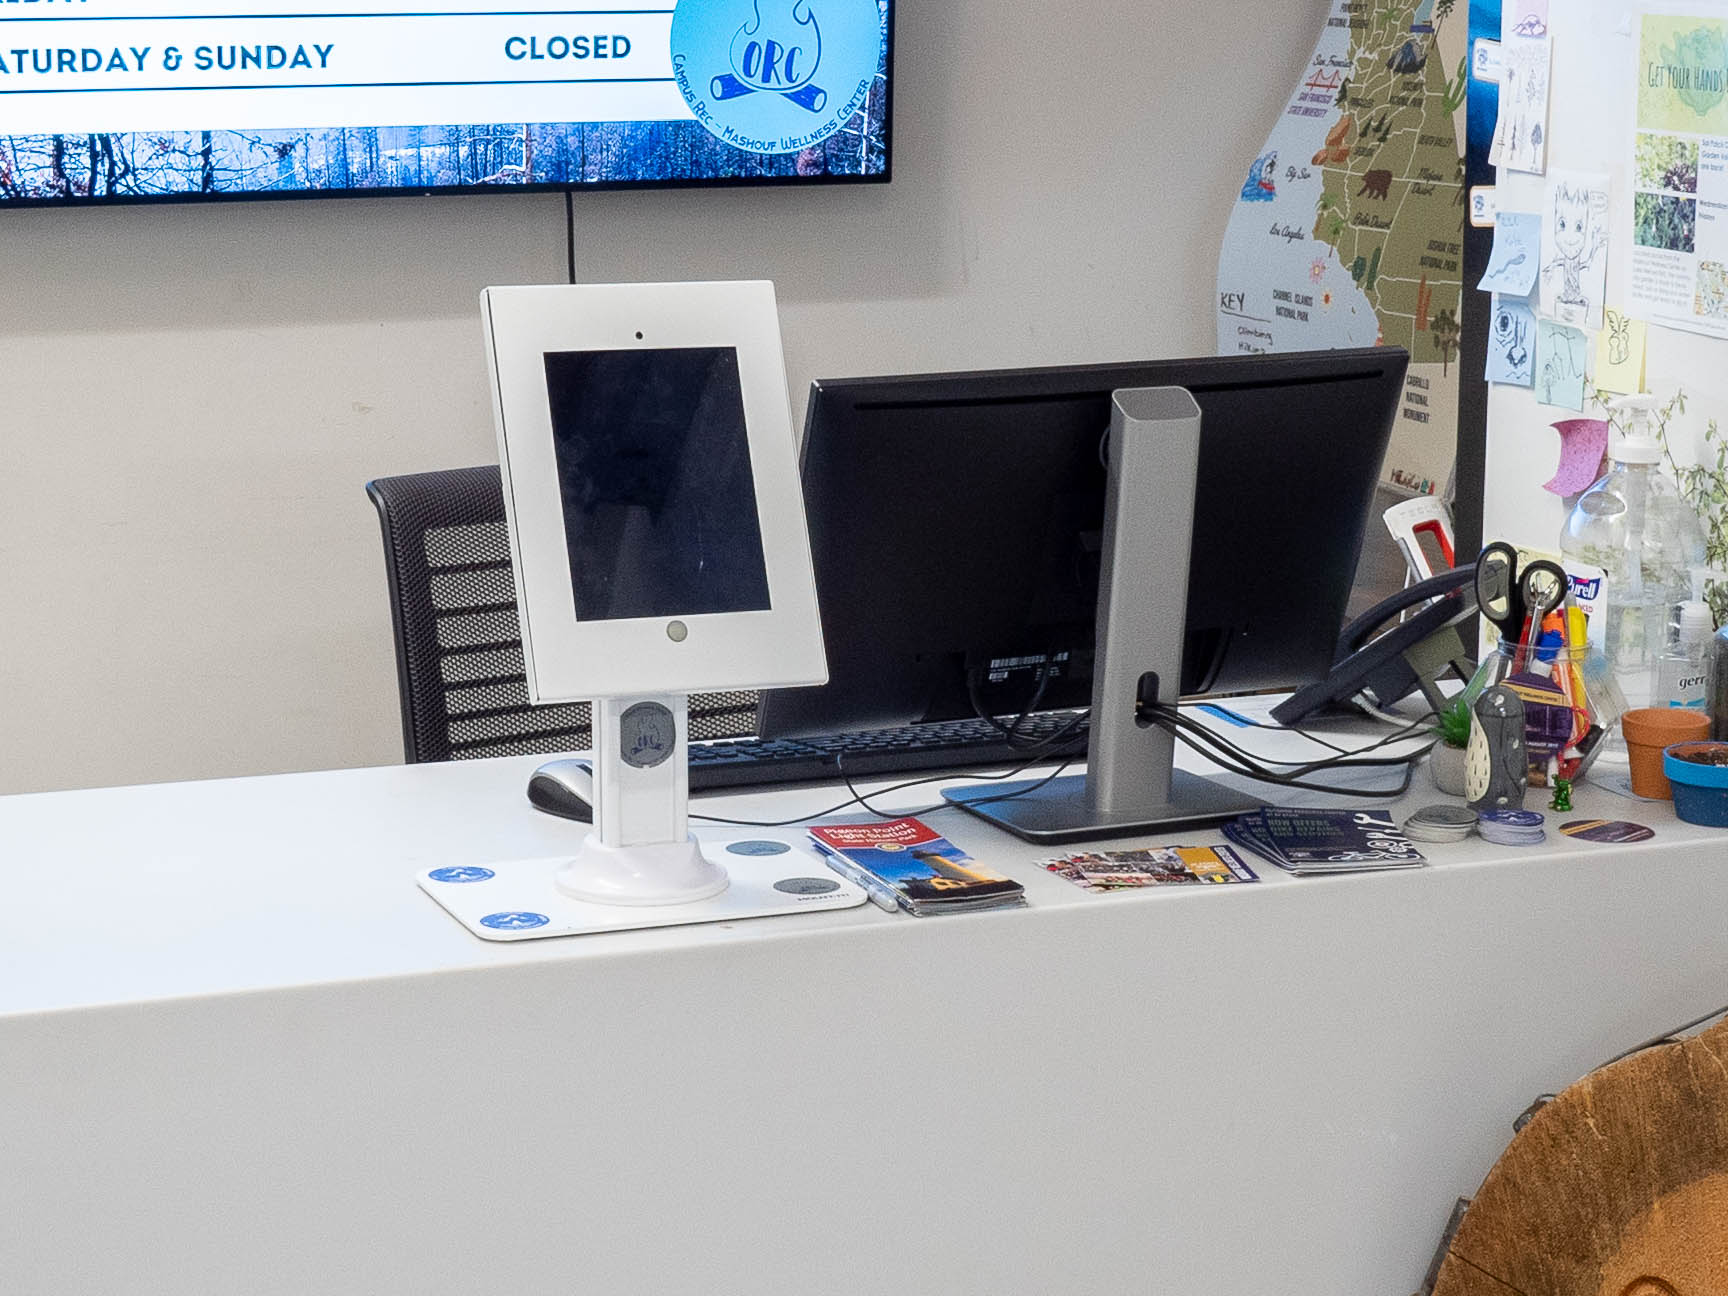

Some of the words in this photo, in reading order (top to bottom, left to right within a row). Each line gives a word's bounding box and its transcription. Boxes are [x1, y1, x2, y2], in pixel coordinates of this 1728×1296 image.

[163, 47, 183, 71] &
[194, 43, 335, 70] SUNDAY
[504, 35, 632, 60] CLOSED
[743, 39, 803, 86] ORC
[1647, 62, 1665, 88] GET
[1667, 64, 1690, 90] YOUR
[1694, 66, 1723, 93] HANDS
[673, 53, 697, 104] CAMPUS
[693, 100, 713, 126] REC
[721, 125, 776, 151] MASHOUF
[780, 119, 838, 151] WELLNESS
[836, 78, 870, 121] CENTER
[1285, 165, 1297, 182] Big
[1298, 167, 1311, 180] Sur
[1269, 222, 1284, 236] Los
[1283, 225, 1305, 243] Angeles
[1220, 292, 1245, 311] KEY
[1272, 289, 1293, 304] CHANNEL
[1275, 306, 1297, 321] NATIONAL
[1296, 309, 1309, 322] PARK
[1406, 374, 1429, 390] CABRILLO
[1406, 391, 1429, 407] NATIONAL
[1403, 408, 1430, 424] MONUMENT
[866, 827, 916, 838] Station
[872, 822, 910, 833] Point
